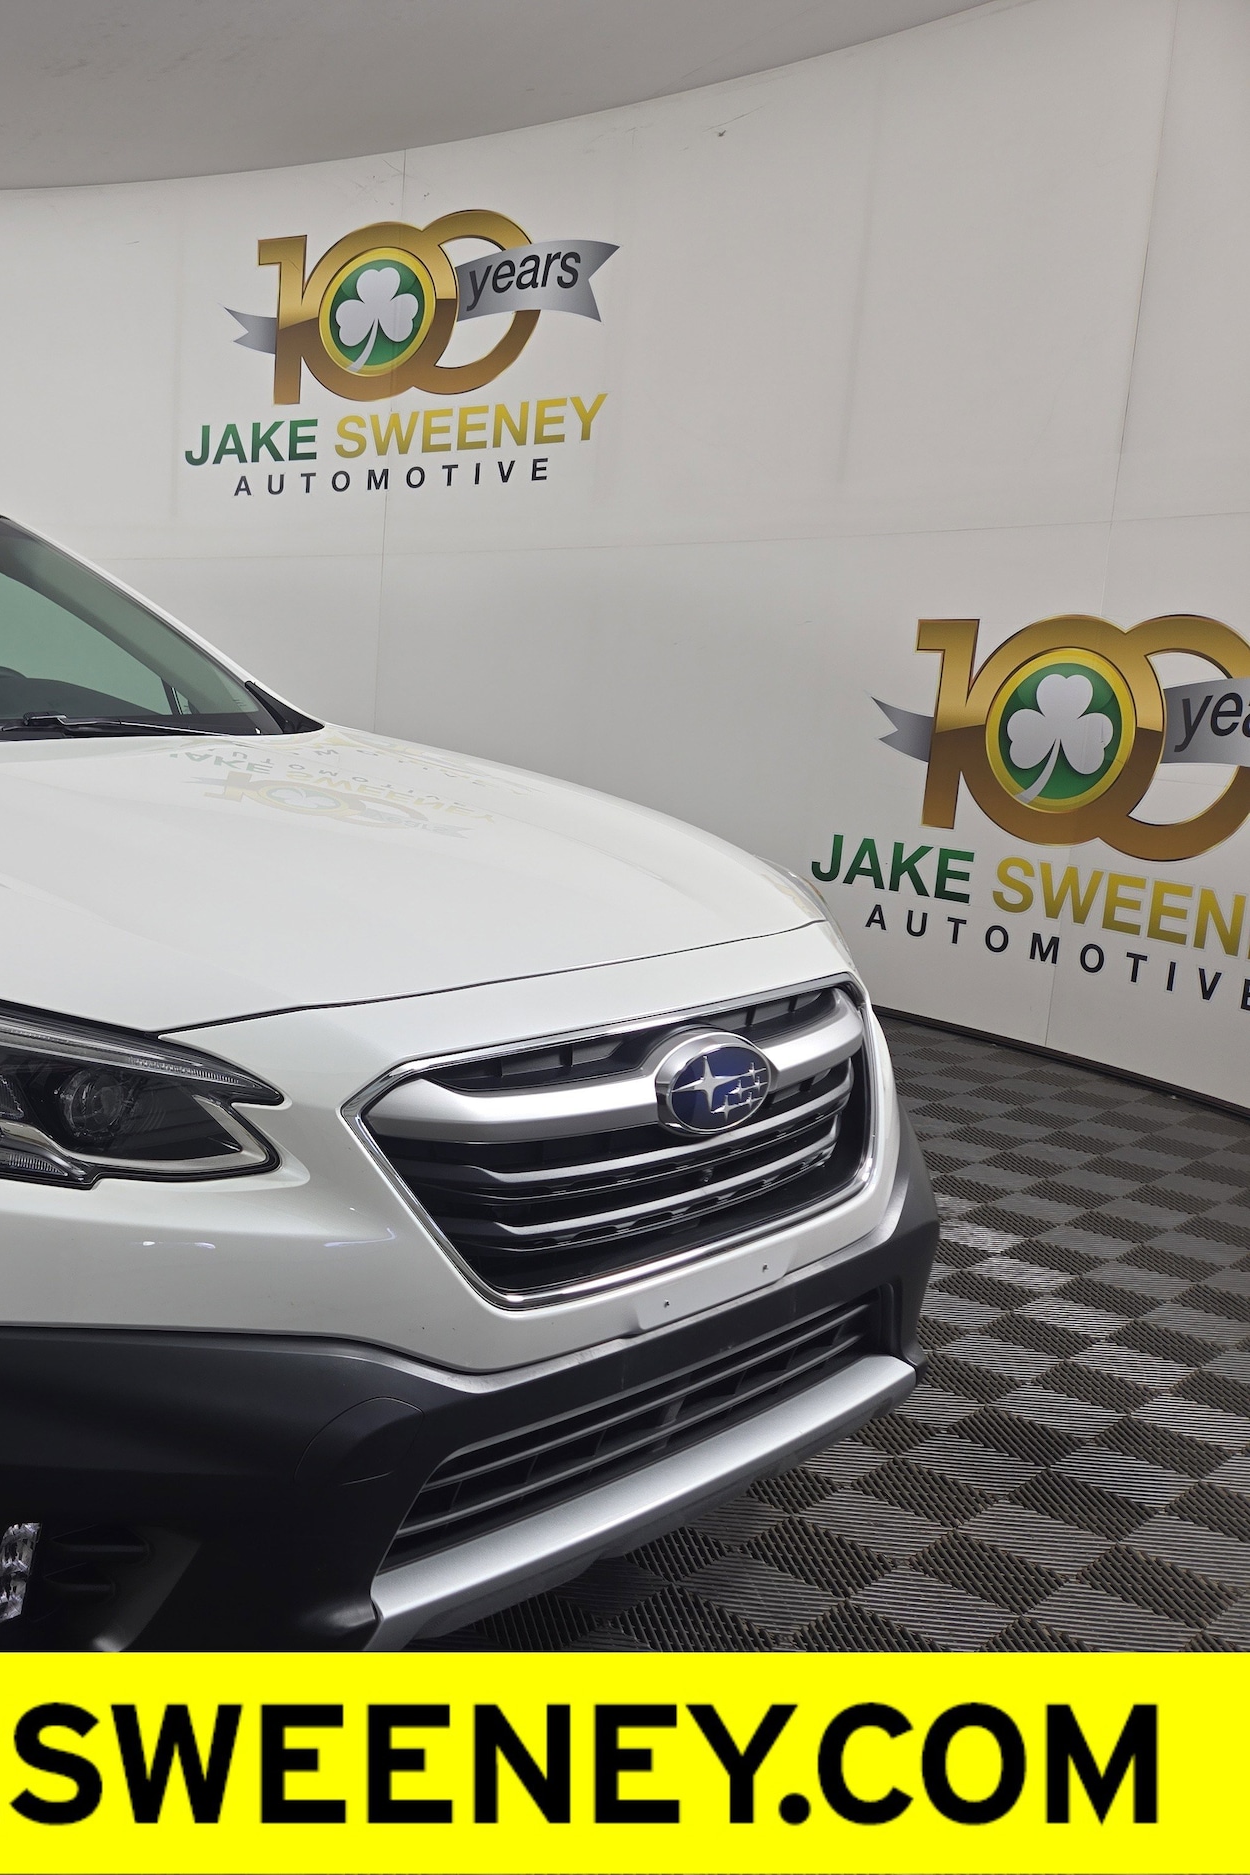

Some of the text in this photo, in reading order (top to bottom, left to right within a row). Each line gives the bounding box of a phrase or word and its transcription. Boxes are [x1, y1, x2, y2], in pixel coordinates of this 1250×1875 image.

[465, 249, 582, 312] years
[185, 393, 608, 466] JAKE SWEENEY
[234, 458, 549, 497] AUTOMOTIVE
[1174, 692, 1250, 753] ye
[811, 834, 1250, 960] JAKE SWEEN
